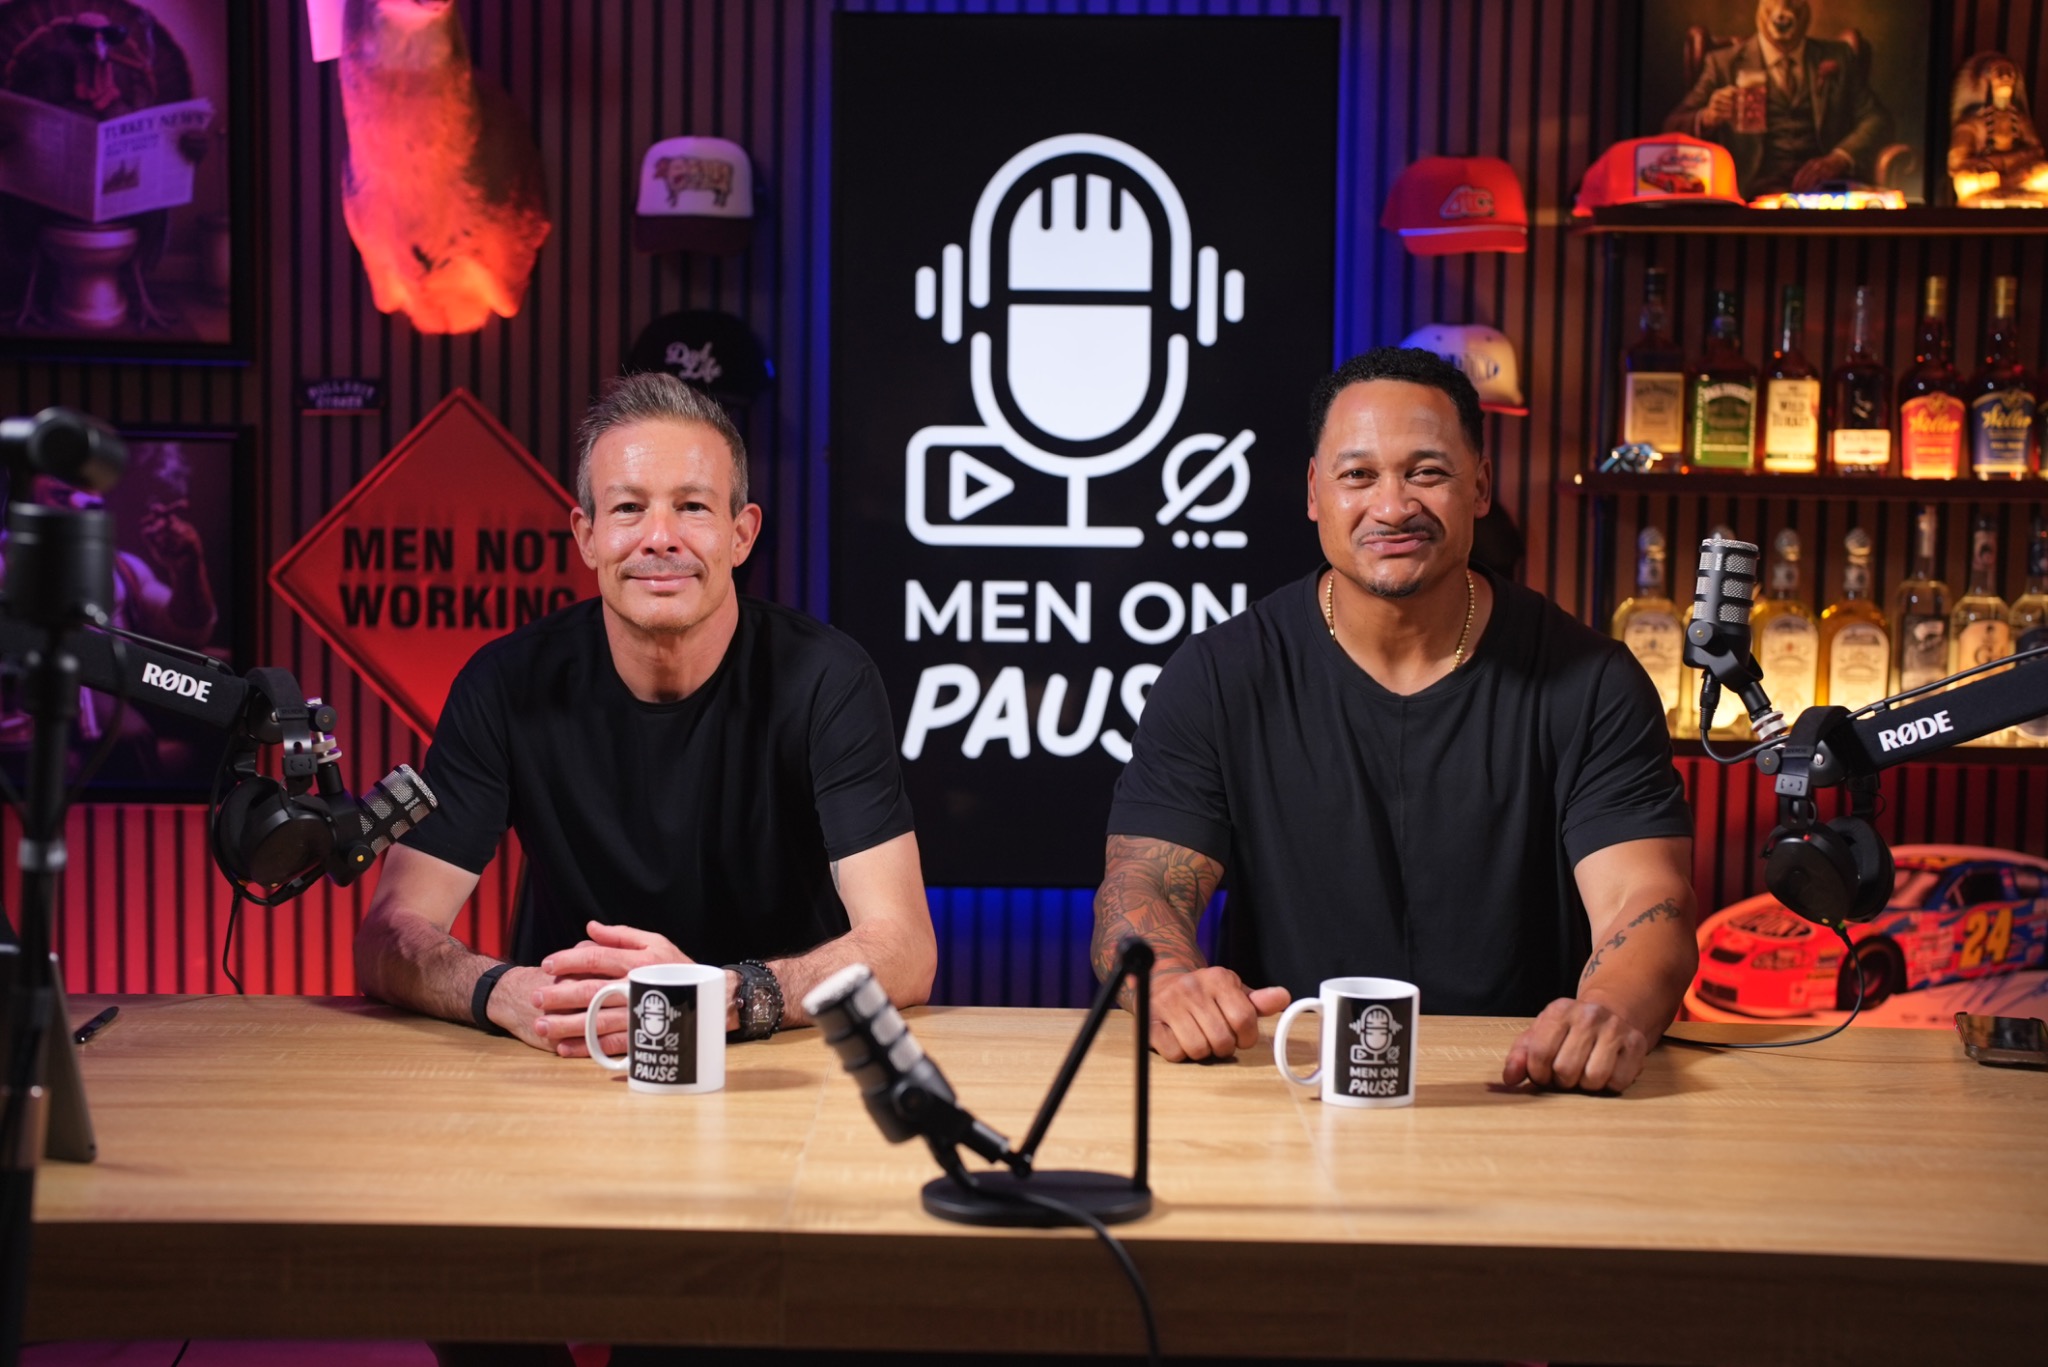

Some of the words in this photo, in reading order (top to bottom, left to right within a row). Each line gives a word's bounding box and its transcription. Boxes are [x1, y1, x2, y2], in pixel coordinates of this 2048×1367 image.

[104, 117, 153, 139] TURKEY
[342, 528, 454, 572] MEN
[477, 529, 575, 574] NOT
[905, 579, 1091, 643] MEN
[1119, 581, 1247, 645] ON
[142, 662, 212, 702] RØDE
[900, 663, 1164, 763] PAUS
[1878, 710, 1954, 752] RØDE
[1959, 908, 2013, 970] 24
[634, 1062, 678, 1082] PAUSE
[635, 1050, 657, 1064] MEN
[659, 1053, 679, 1065] ON
[1349, 1066, 1378, 1078] MEN
[1380, 1067, 1399, 1079] ON
[1348, 1078, 1398, 1096] PAUSE
